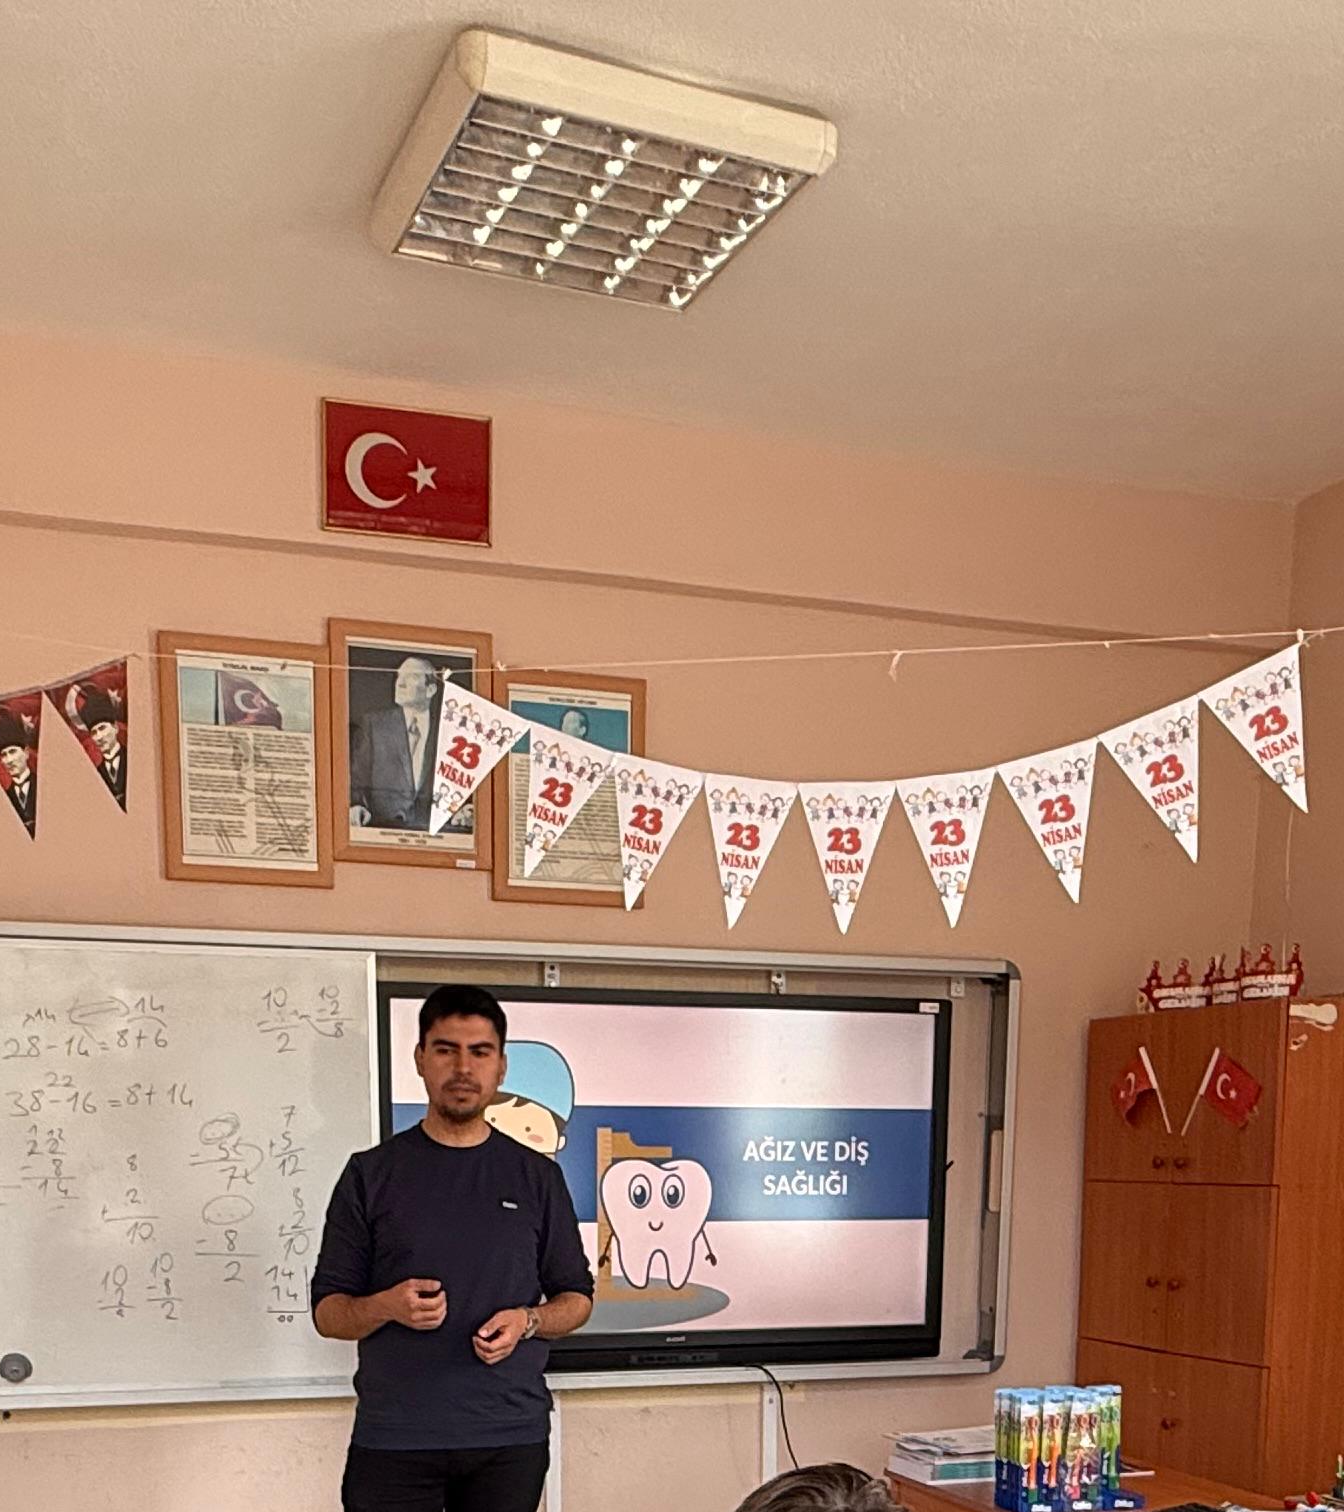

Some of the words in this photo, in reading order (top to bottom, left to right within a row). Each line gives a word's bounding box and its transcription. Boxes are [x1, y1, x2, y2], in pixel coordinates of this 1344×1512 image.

[1249, 706, 1289, 741] 23
[446, 736, 482, 769] 23
[1257, 731, 1300, 764] NİSAN
[437, 760, 475, 789] NİSAN
[1145, 754, 1185, 788] 23
[539, 777, 574, 808] 23
[1151, 780, 1195, 810] NİSAN
[528, 802, 568, 826] NİSAN
[628, 804, 664, 835] 23
[1038, 794, 1076, 825] 23
[622, 831, 662, 855] NİSAN
[725, 822, 760, 851] 23
[827, 827, 862, 855] 23
[930, 818, 966, 847] 23
[1040, 823, 1082, 847] NİSAN
[720, 849, 760, 870] NİSAN
[825, 856, 864, 874] NİSAN
[929, 848, 970, 869] NİSAN
[134, 995, 165, 1014] 14
[261, 986, 288, 1011] 10
[276, 1032, 297, 1053] 2
[45, 1072, 77, 1088] 22
[281, 1105, 295, 1127] 7
[126, 1154, 137, 1171] 8
[743, 1136, 795, 1161] AĞIZ
[801, 1141, 829, 1161] VE
[835, 1136, 869, 1165] DİŞ
[277, 1154, 306, 1176] 12
[763, 1170, 848, 1195] SAĞLIĞI
[126, 1188, 141, 1204] 2
[293, 1187, 304, 1208] 8
[127, 1222, 154, 1244] 10
[283, 1233, 309, 1261] 10
[150, 1252, 173, 1277] 10
[224, 1261, 245, 1282] 2
[161, 1301, 178, 1320] 2
